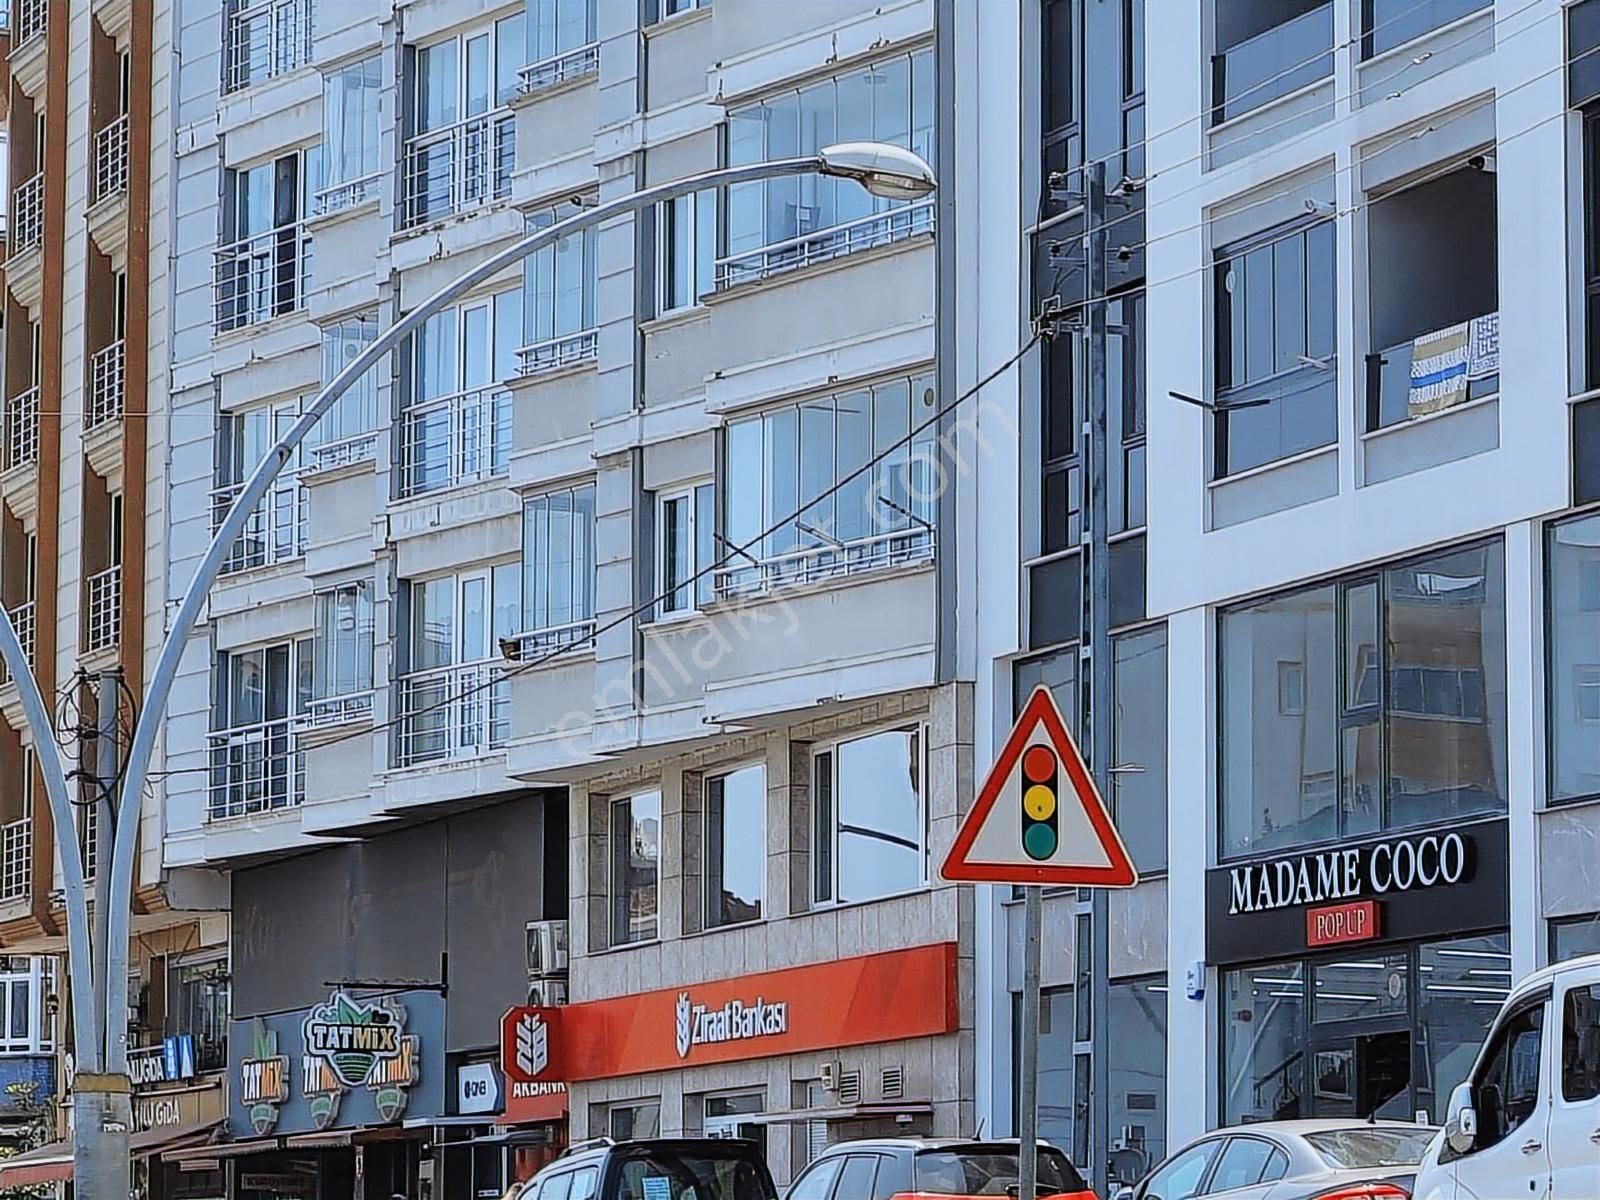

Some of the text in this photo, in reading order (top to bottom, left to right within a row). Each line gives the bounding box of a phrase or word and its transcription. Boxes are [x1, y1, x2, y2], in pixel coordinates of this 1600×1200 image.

[1229, 833, 1465, 914] MADAME COCO
[1317, 912, 1344, 940] POP
[691, 996, 787, 1044] Ziraat Bankası
